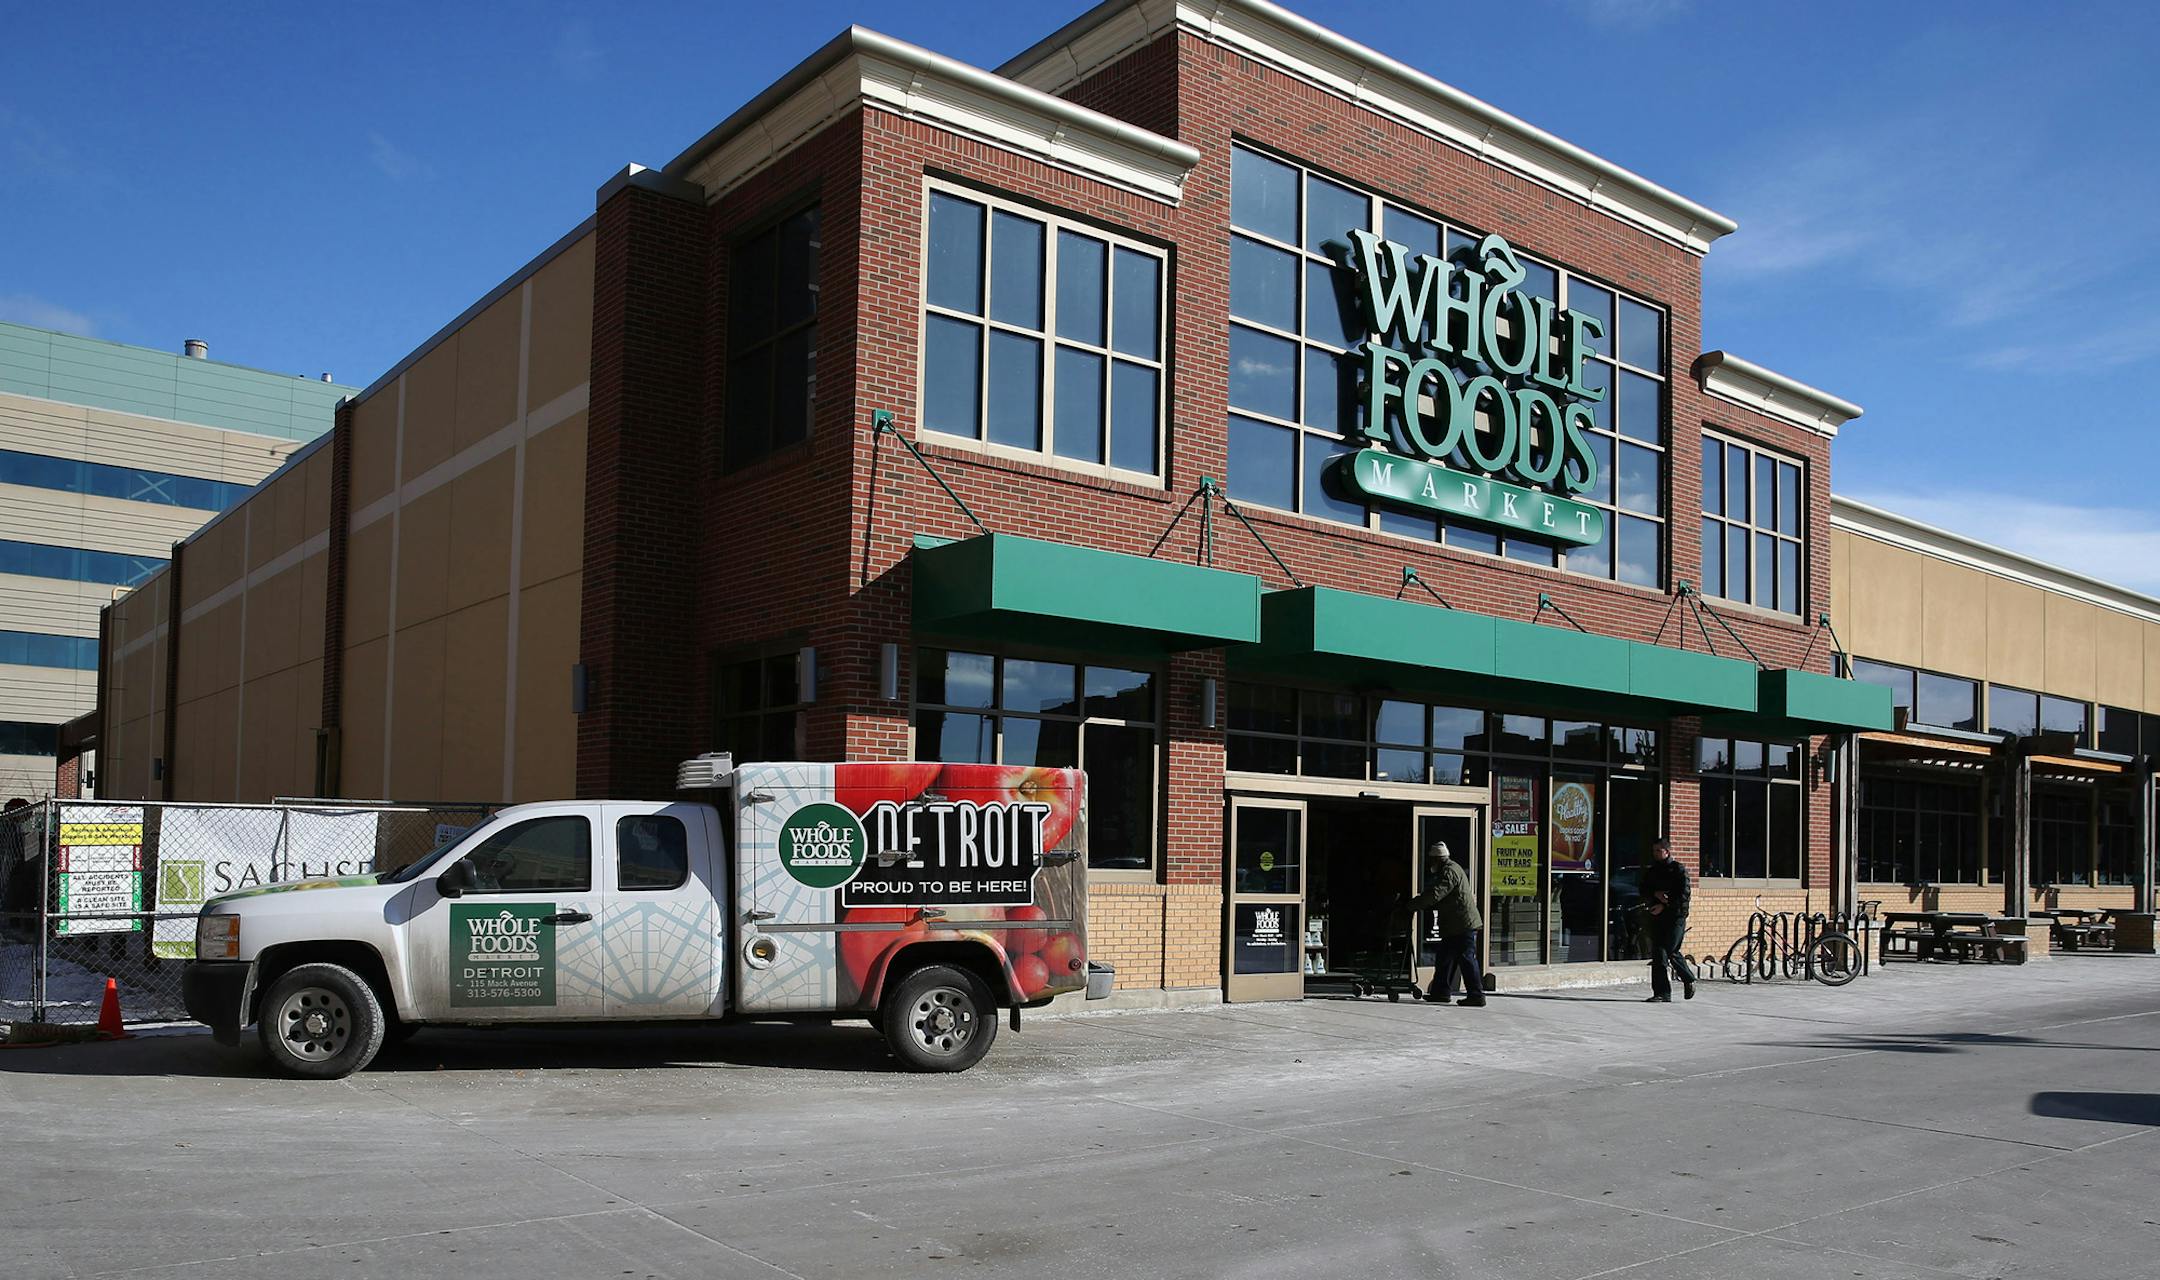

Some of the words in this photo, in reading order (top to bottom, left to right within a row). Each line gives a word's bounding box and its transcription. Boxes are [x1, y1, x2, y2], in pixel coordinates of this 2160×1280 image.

[1352, 229, 1606, 402] WHOLE
[1362, 341, 1598, 494] FOODS
[1370, 458, 1591, 536] MARKET
[788, 821, 854, 843] WHOLE
[1505, 823, 1528, 835] SALE!
[877, 804, 1048, 868] DETROIT
[792, 843, 852, 859] FOODS
[1496, 847, 1517, 858] FRUIT
[1517, 848, 1533, 858] AND
[1497, 858, 1512, 868] NUT
[1513, 859, 1531, 868] BARS
[851, 881, 914, 894] PROUD
[918, 880, 944, 894] TO
[949, 880, 972, 893] BE
[977, 880, 1027, 893] HERE!
[1502, 875, 1507, 886] 4
[1507, 875, 1518, 886] for
[1255, 908, 1280, 920] WHOLE
[466, 910, 541, 936] WHOLE
[1256, 920, 1280, 929] FOODS
[470, 935, 538, 953] FOODS
[463, 967, 545, 979] DETROIT
[470, 979, 485, 988] 115
[487, 979, 509, 988] Mack
[510, 980, 539, 988] Avenue
[467, 988, 541, 998] 313-576-5300
